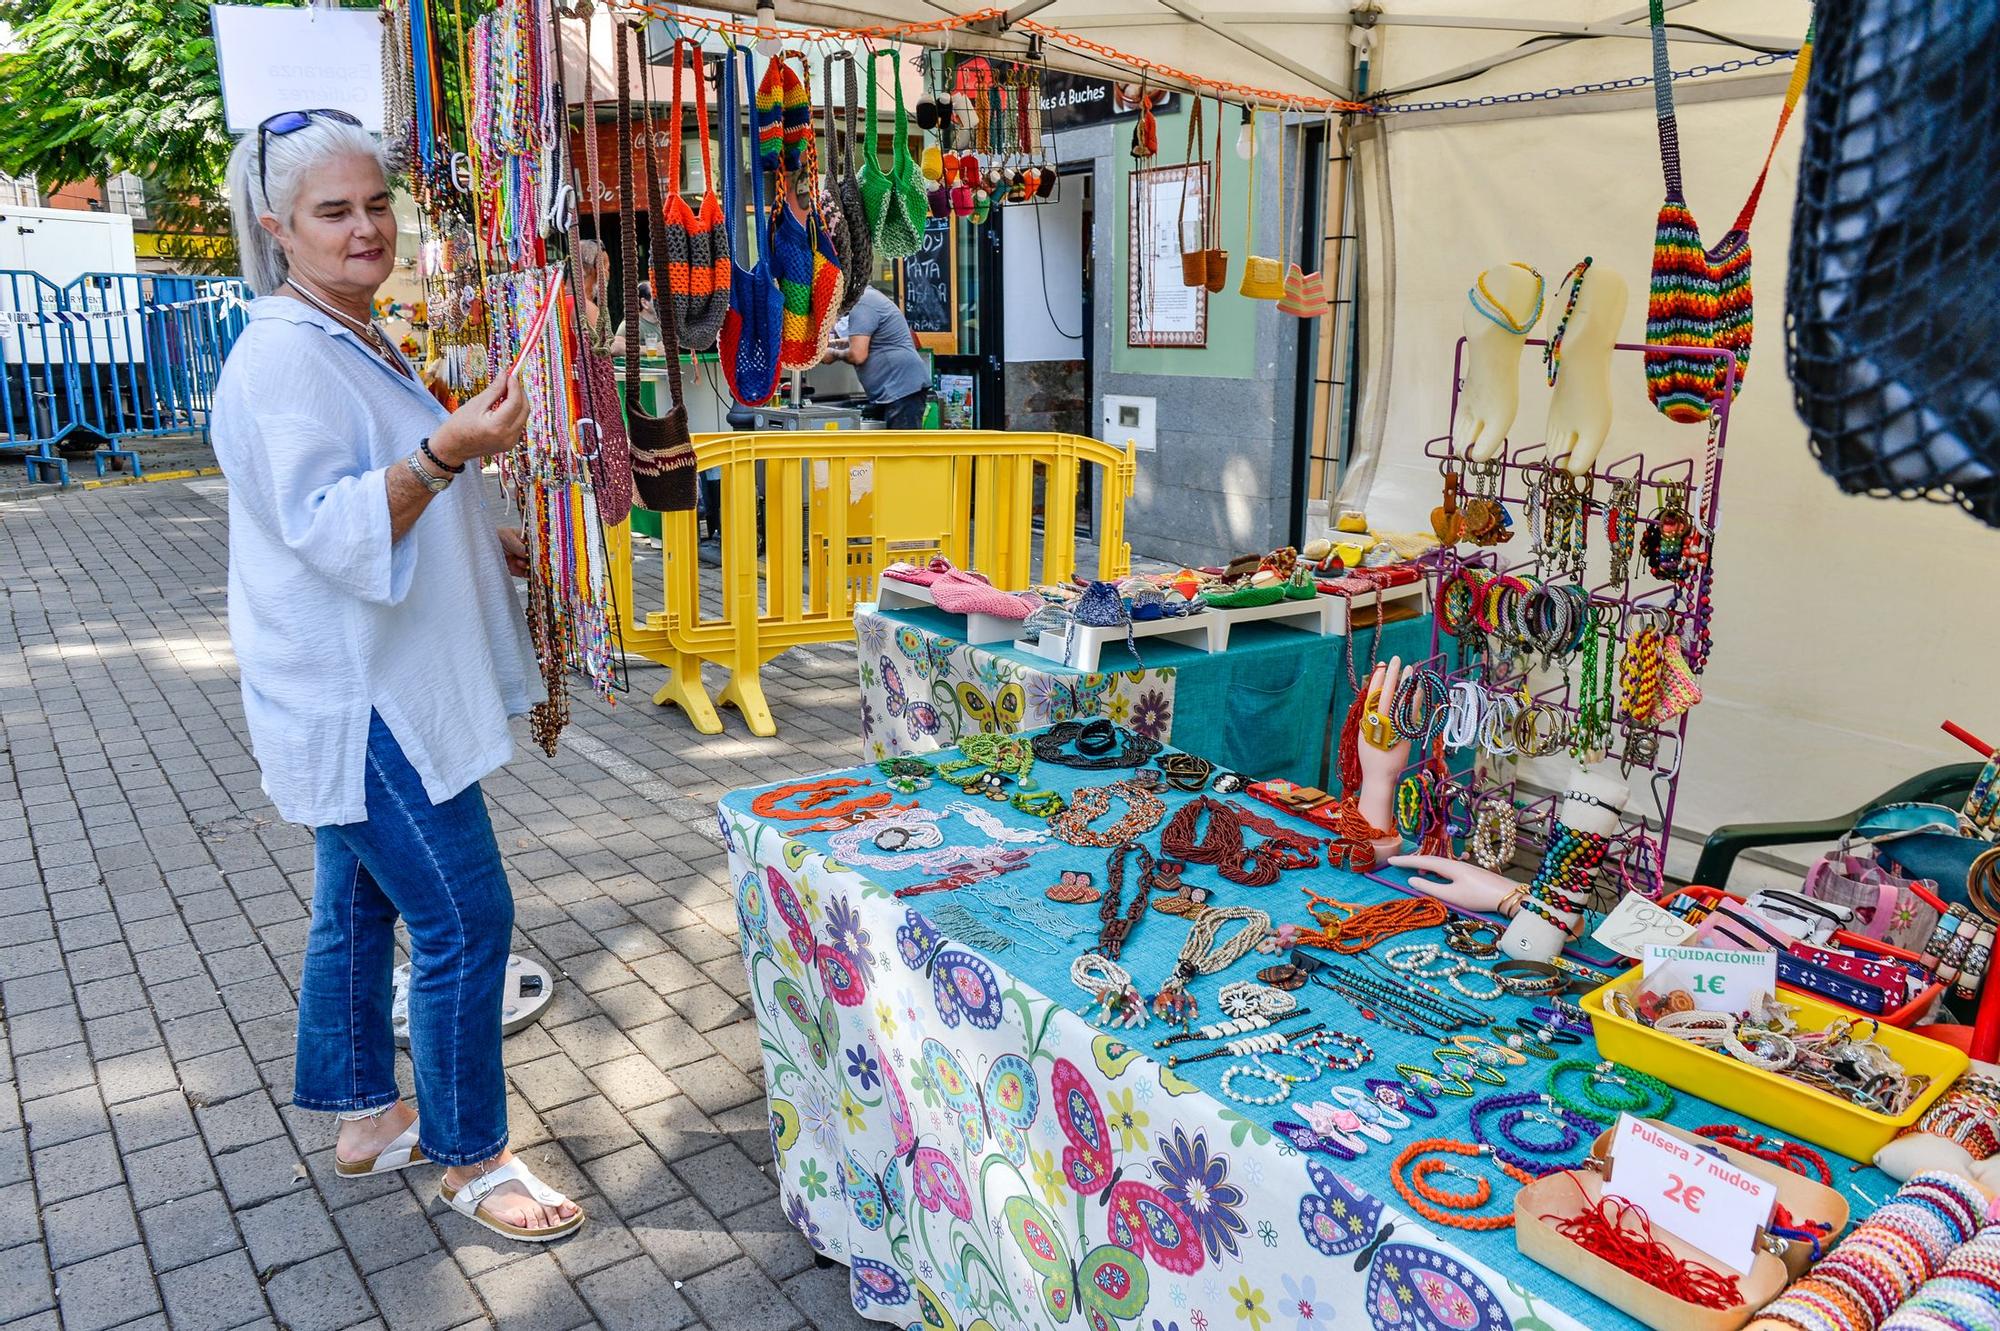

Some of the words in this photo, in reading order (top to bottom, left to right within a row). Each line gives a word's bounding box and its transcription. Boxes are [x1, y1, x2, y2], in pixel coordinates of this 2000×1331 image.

[1058, 91, 1067, 107] &
[1068, 85, 1105, 105] Buches
[922, 231, 944, 253] OY
[905, 256, 941, 279] PATA
[1625, 898, 1686, 938] TODO
[1520, 938, 1528, 947] 5
[1653, 947, 1766, 966] LIQUIDACIÓN!!!
[1693, 973, 1727, 995] 1€
[1631, 1123, 1690, 1162] Pulsera
[1694, 1152, 1707, 1167] 7
[1707, 1162, 1761, 1197] nudos
[1663, 1173, 1706, 1214] 2€
